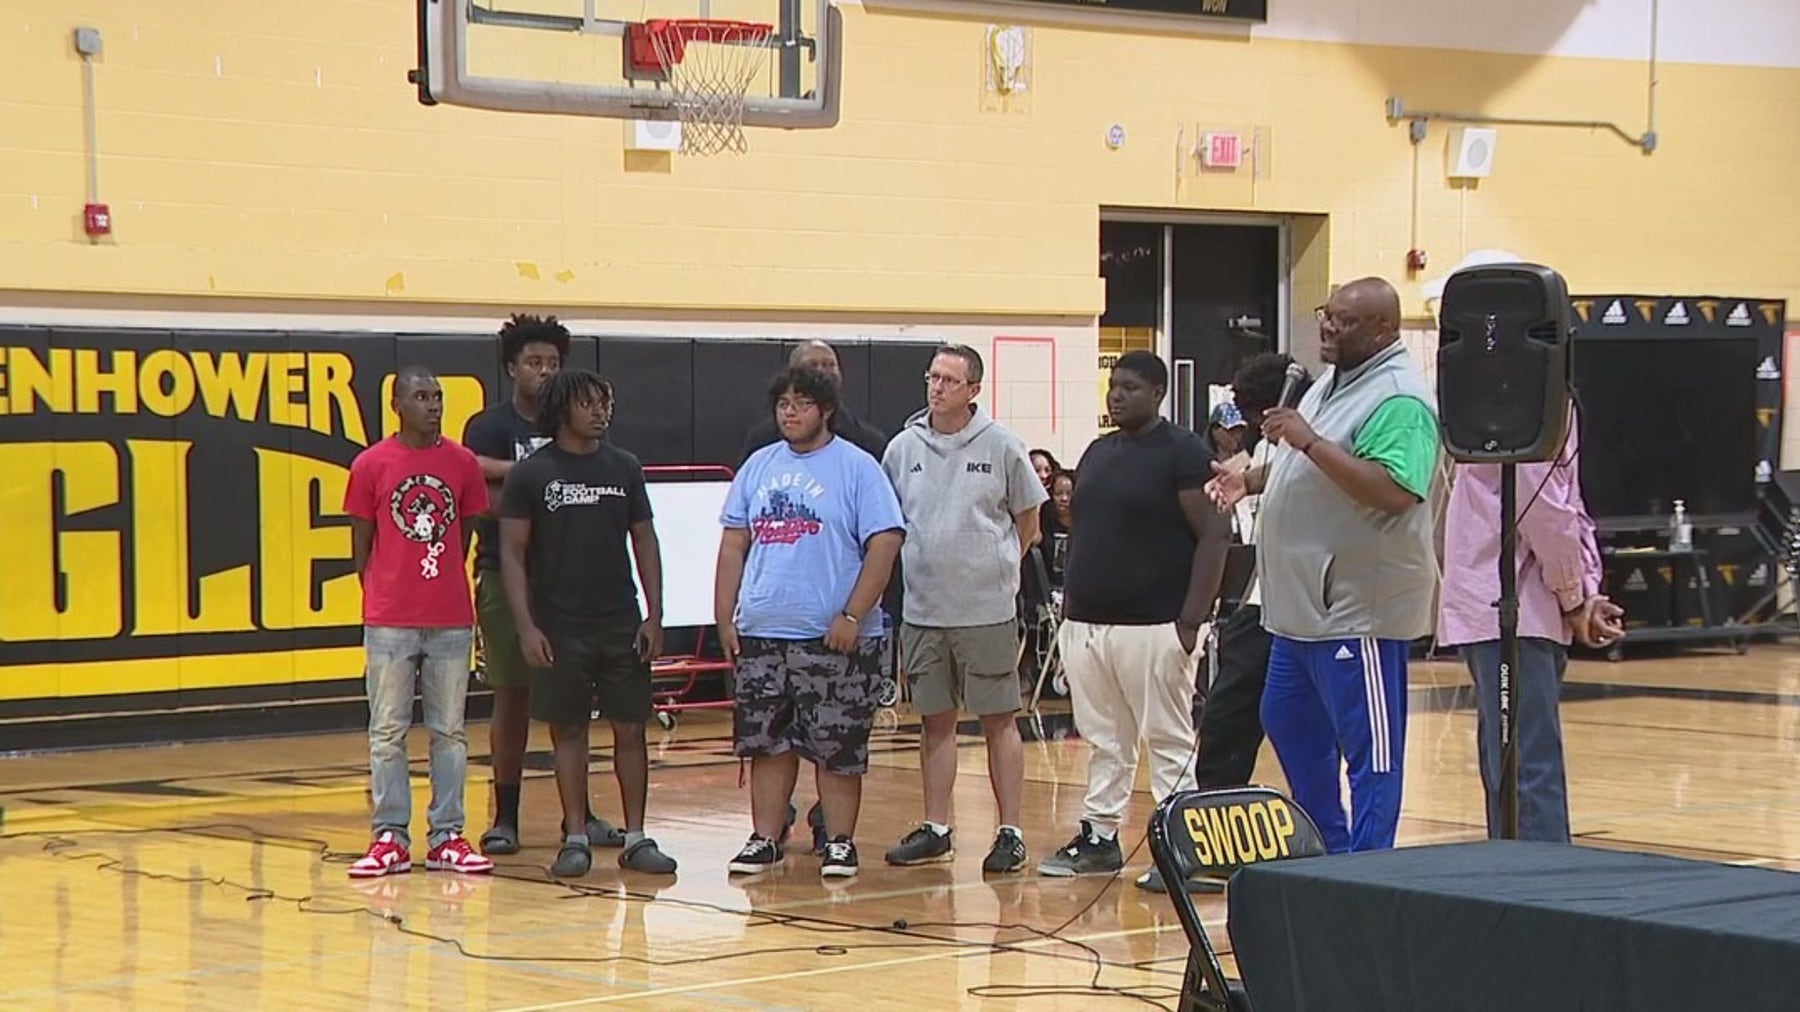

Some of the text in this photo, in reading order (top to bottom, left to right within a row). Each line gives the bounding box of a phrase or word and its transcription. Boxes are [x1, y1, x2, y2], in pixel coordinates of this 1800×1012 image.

[1211, 135, 1238, 164] EXIT
[0, 346, 368, 446] NHOWER
[965, 462, 992, 475] IKE
[562, 486, 627, 497] FOOTBALL
[756, 472, 826, 499] MADE IN
[563, 495, 601, 504] CAMP
[1183, 798, 1296, 866] SWOOP
